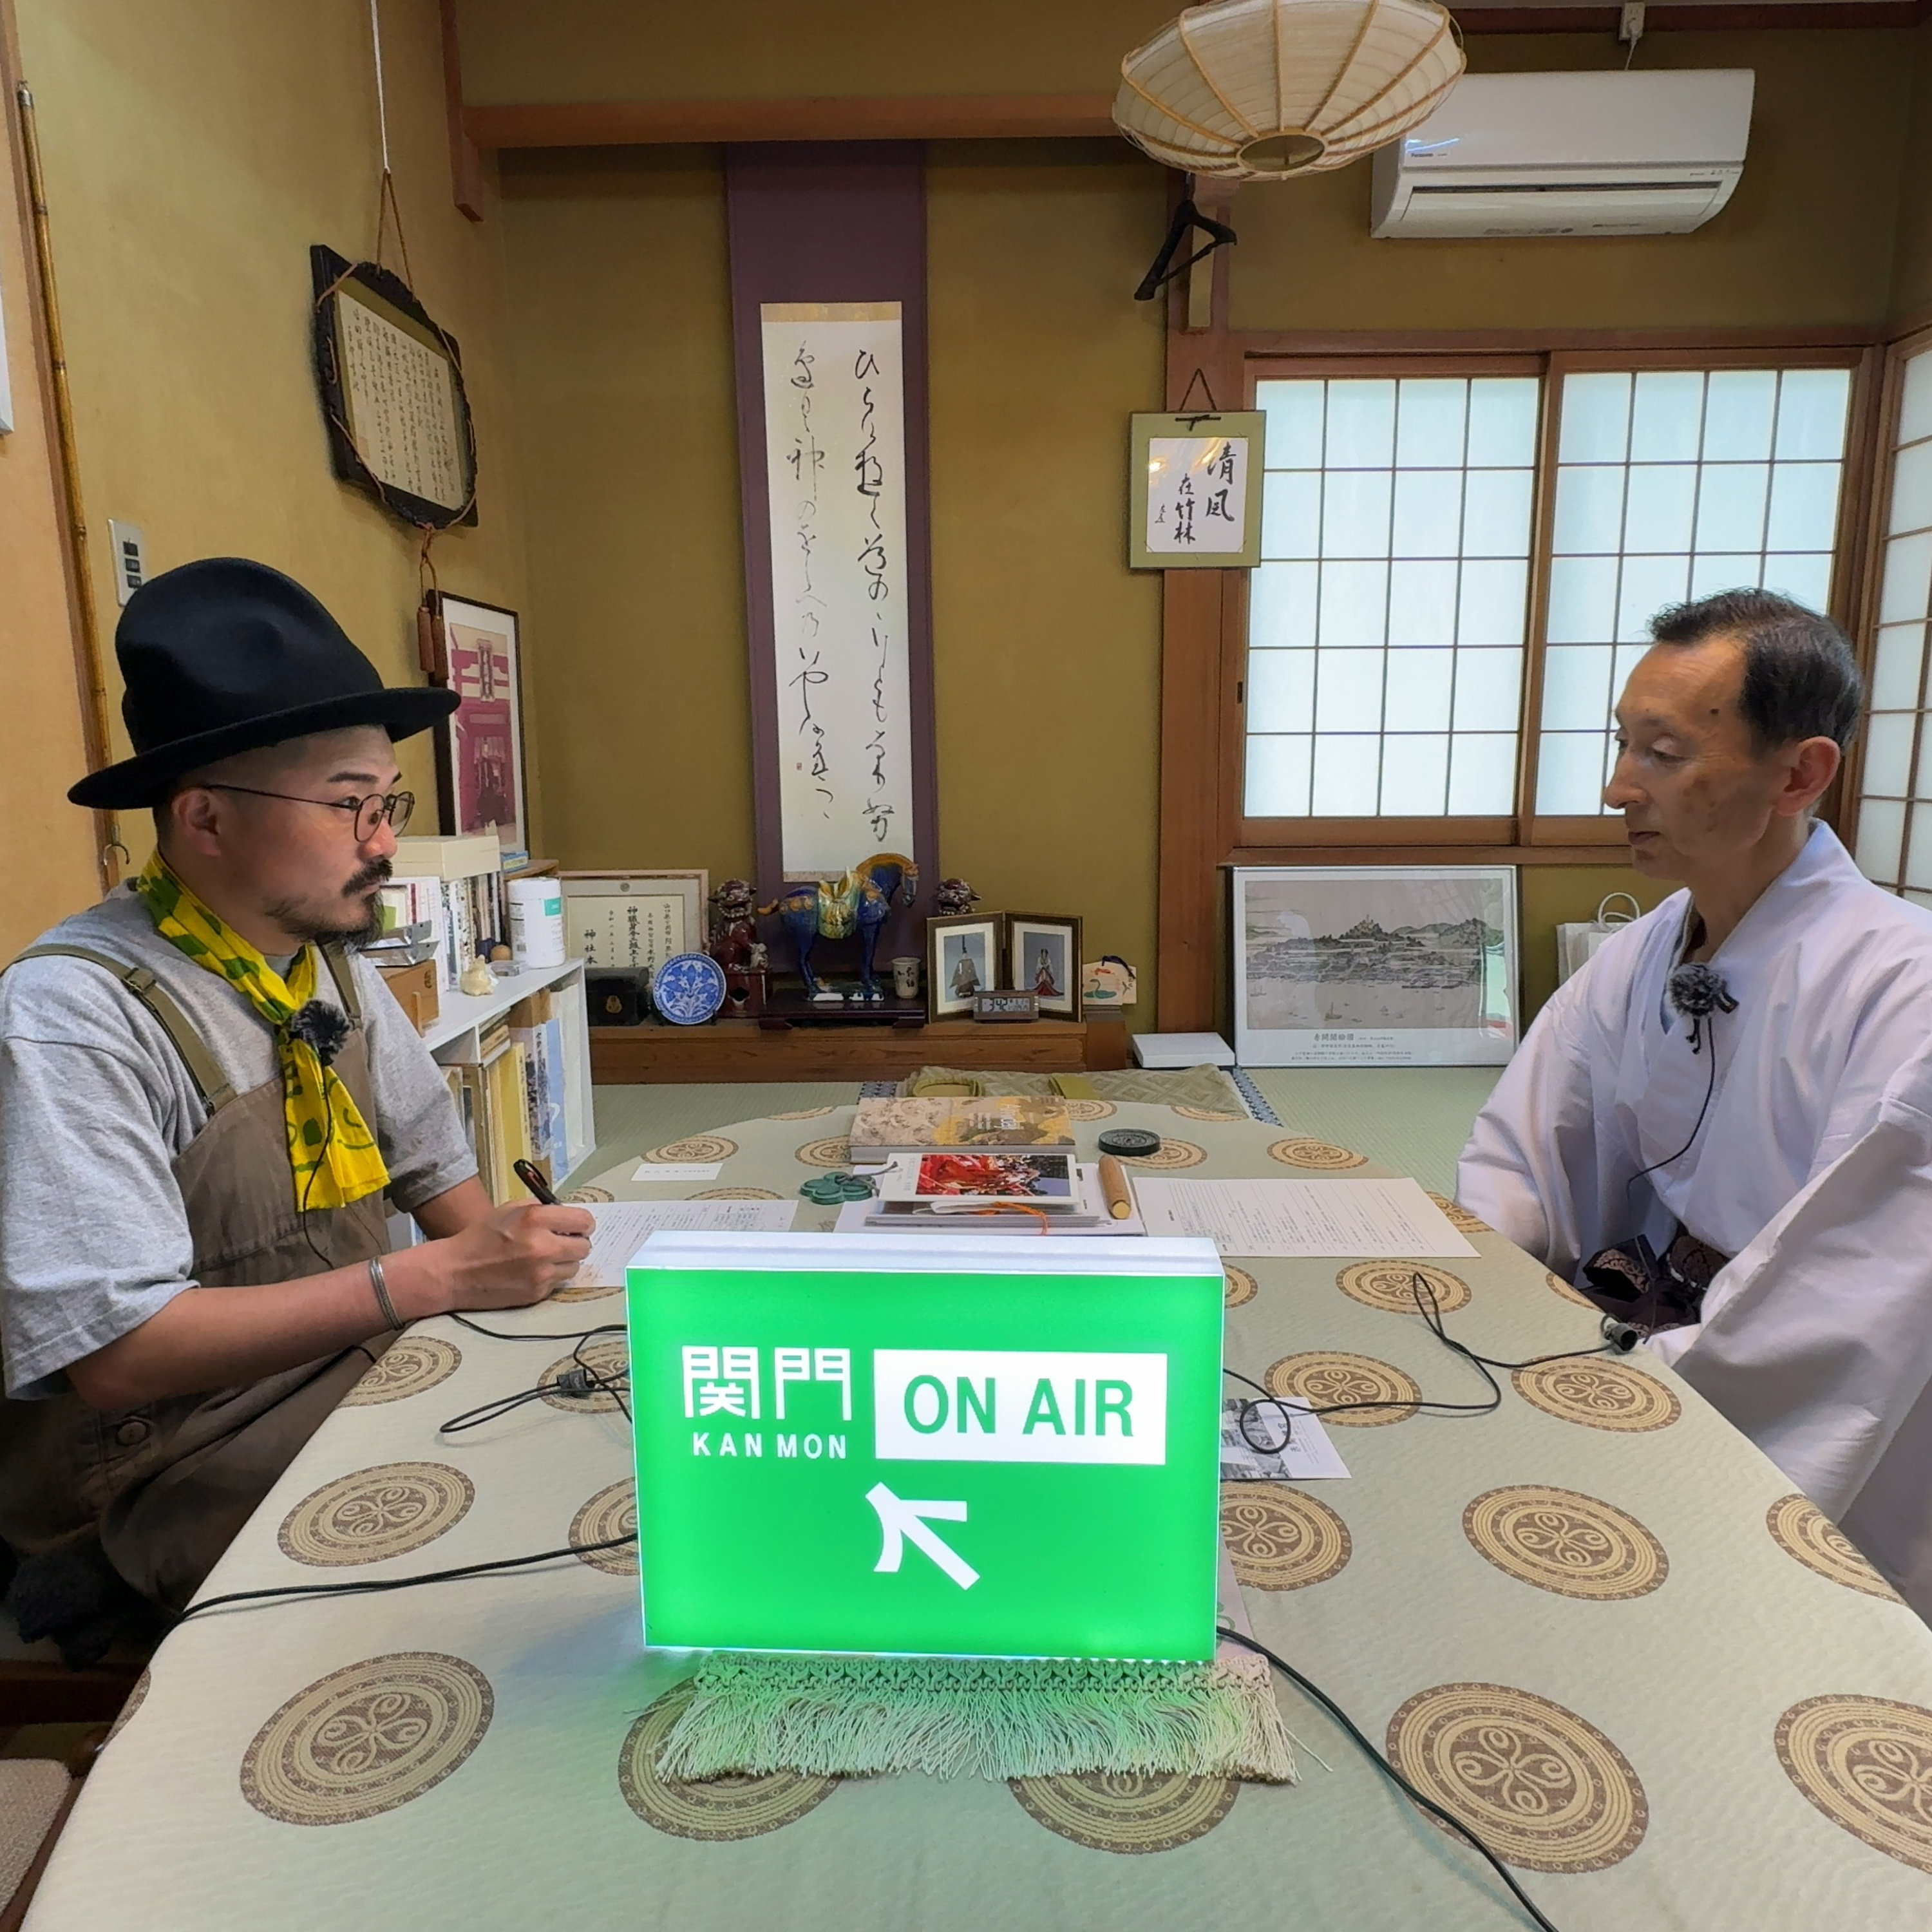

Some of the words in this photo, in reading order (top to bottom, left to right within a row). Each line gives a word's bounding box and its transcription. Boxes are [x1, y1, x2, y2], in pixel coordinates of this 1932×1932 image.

[1174, 473, 1196, 545] 在竹林
[1206, 442, 1236, 522] 清風
[681, 1345, 852, 1421] 関門
[904, 1374, 996, 1435] ON
[1023, 1378, 1135, 1437] AIR
